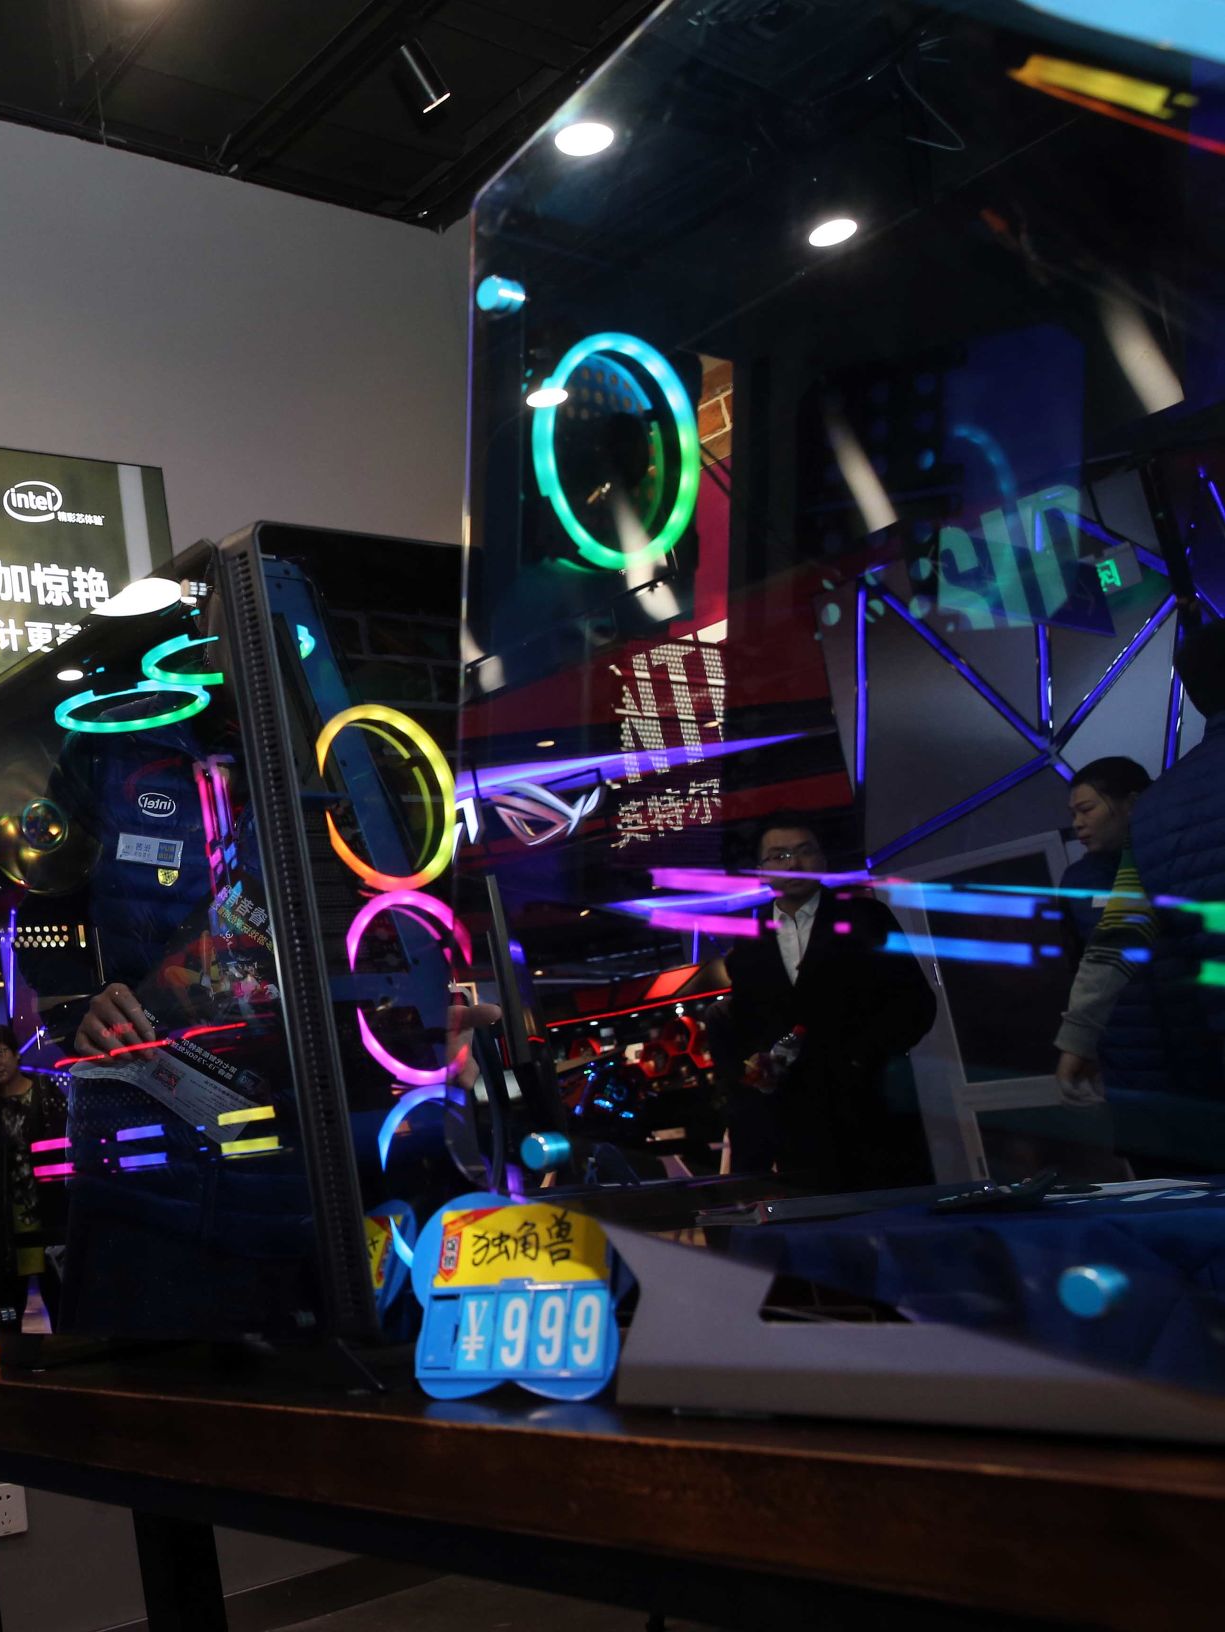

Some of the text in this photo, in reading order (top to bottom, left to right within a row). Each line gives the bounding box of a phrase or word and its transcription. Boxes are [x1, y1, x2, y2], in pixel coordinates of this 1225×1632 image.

[9, 487, 56, 512] intel
[471, 1211, 576, 1267] 独角兽
[461, 1294, 601, 1368] ¥999
